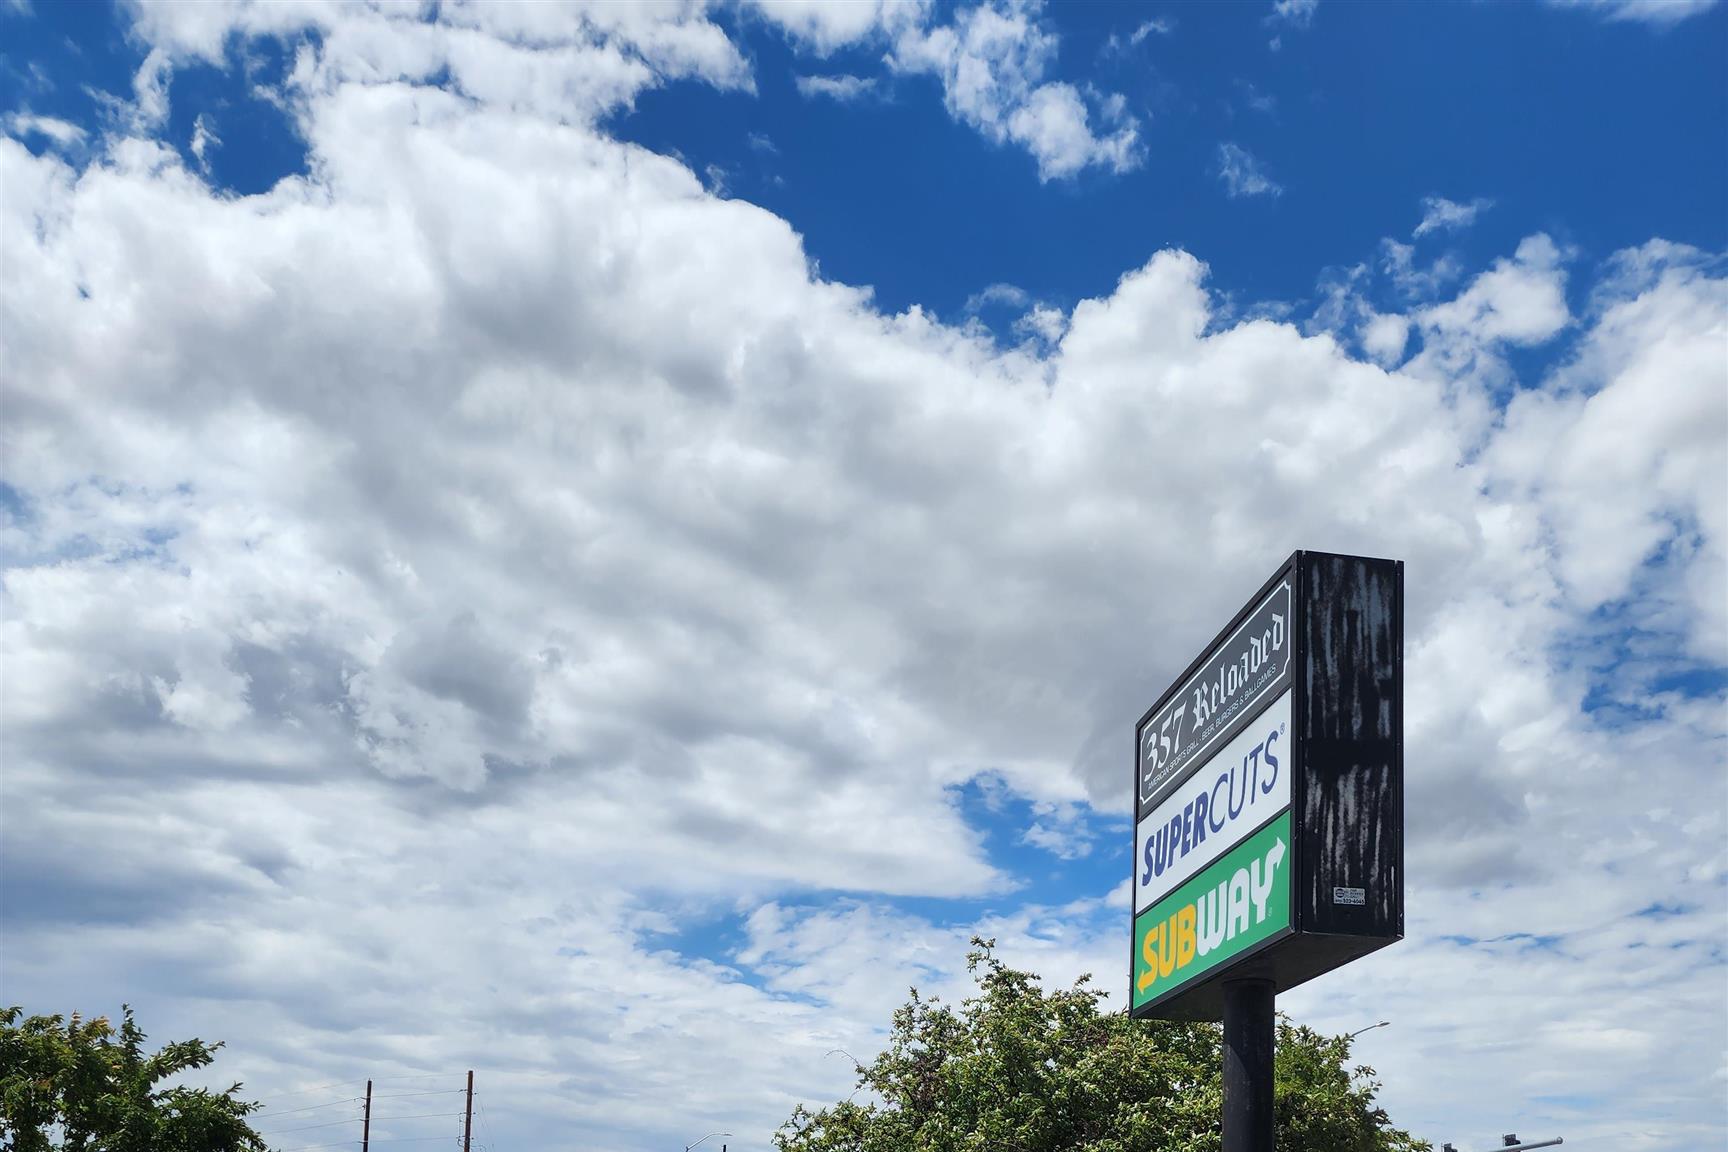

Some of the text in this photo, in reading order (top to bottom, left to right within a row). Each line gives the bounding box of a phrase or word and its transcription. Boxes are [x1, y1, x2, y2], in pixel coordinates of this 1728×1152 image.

[1144, 613, 1284, 782] 357 Reloaded
[1148, 765, 1170, 791] AMERICAN
[1169, 749, 1187, 771] SPORTS
[1186, 738, 1199, 755] GRILL
[1215, 699, 1239, 728] BURGERS
[1244, 663, 1277, 701] BALLGAMES
[1142, 730, 1279, 887] SUPERCUTS
[1137, 837, 1286, 995] SUBWAY
